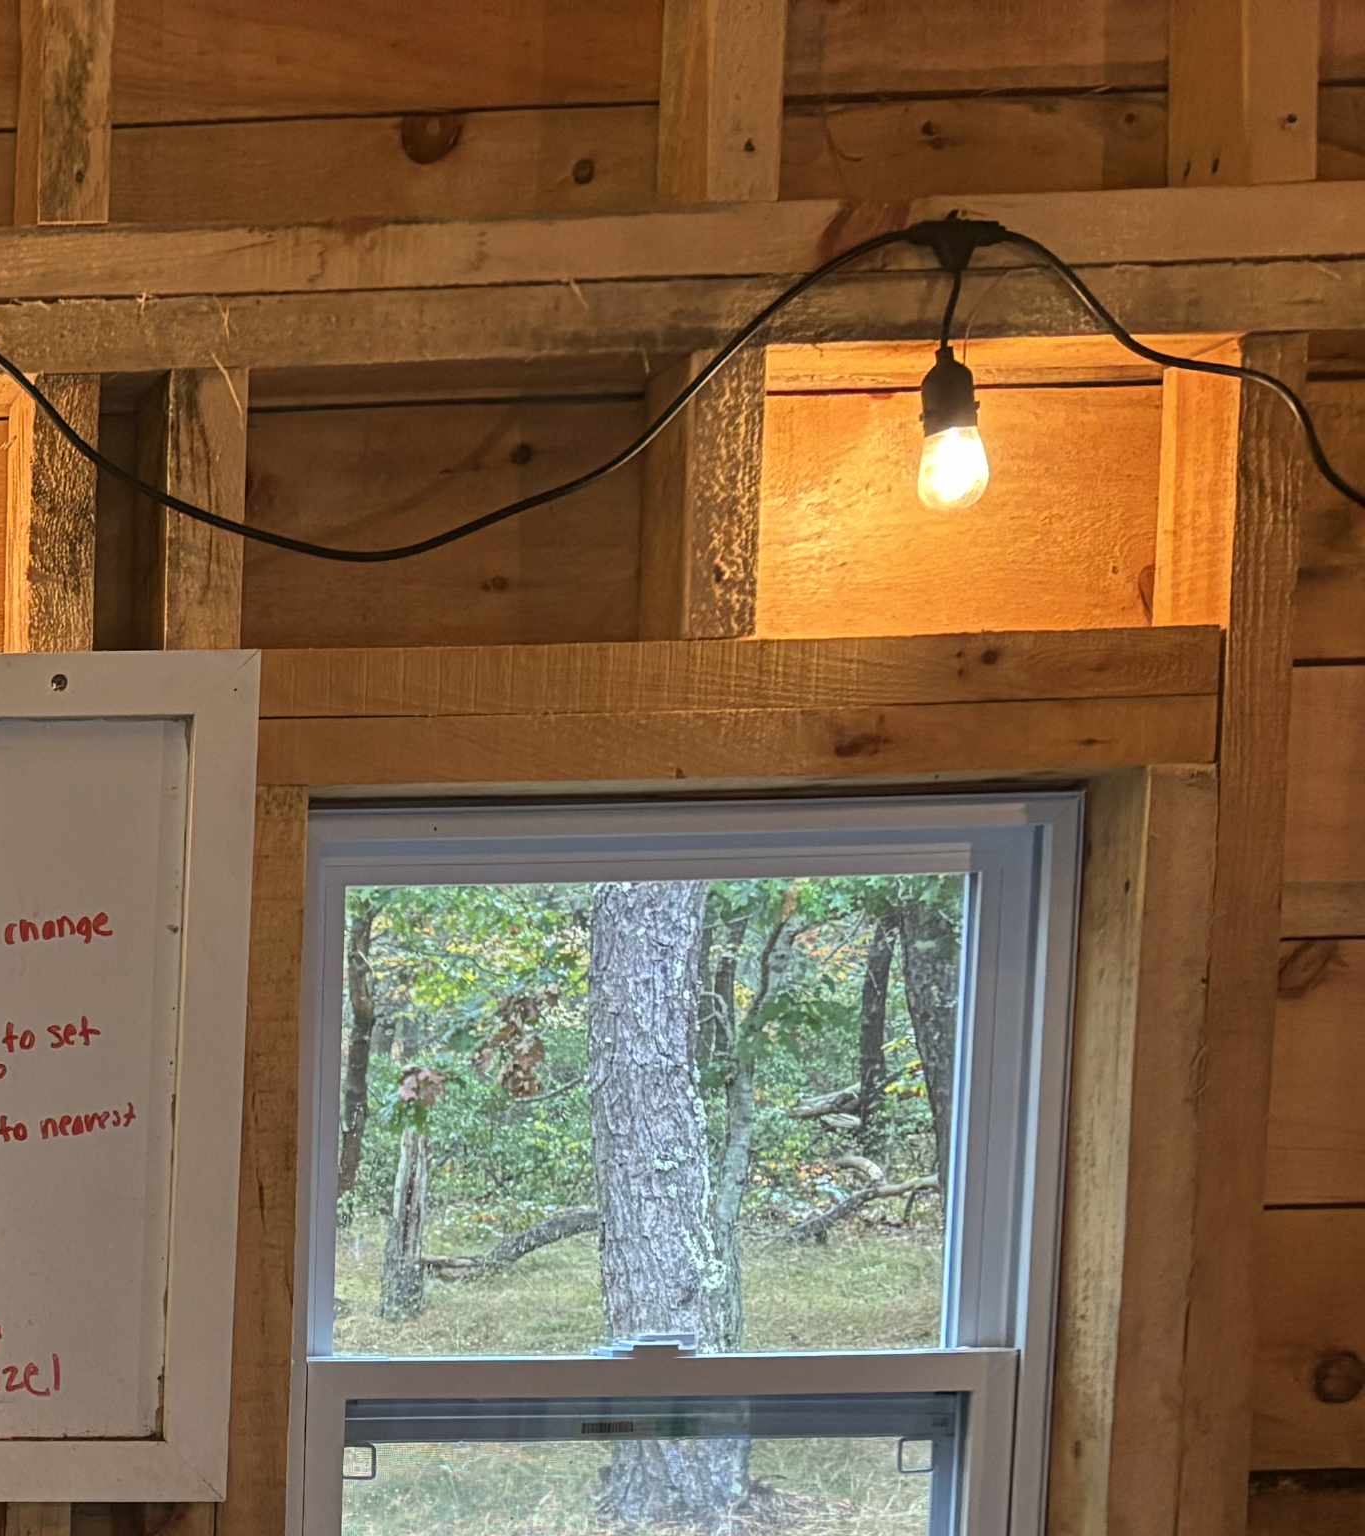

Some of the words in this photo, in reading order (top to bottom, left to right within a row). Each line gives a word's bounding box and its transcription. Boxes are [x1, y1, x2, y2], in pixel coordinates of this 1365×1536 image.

[5, 912, 113, 944] change
[2, 1022, 35, 1052] to
[46, 1016, 101, 1049] set
[40, 1102, 136, 1139] nearest
